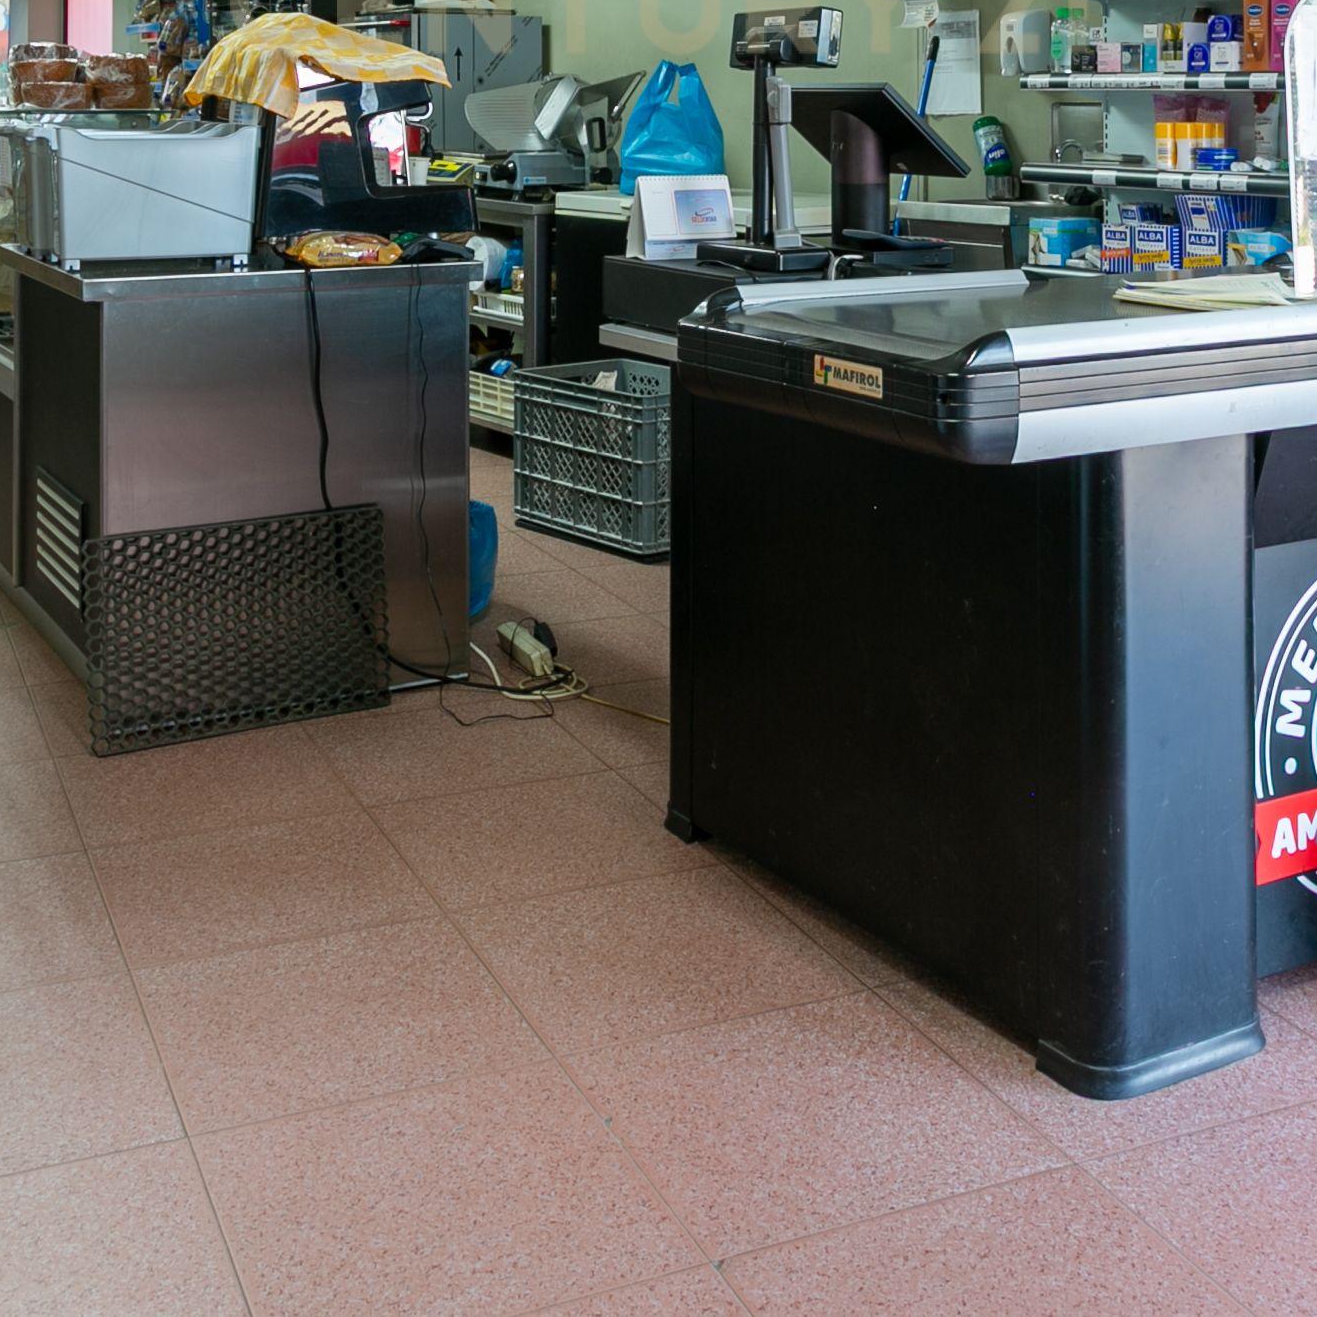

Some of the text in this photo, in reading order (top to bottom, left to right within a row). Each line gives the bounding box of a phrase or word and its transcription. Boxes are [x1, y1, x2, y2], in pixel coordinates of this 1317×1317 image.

[1106, 231, 1126, 239] ALBA
[1138, 231, 1162, 242] ALBA
[1189, 235, 1214, 245] ALBA
[833, 366, 880, 389] MAFIROL
